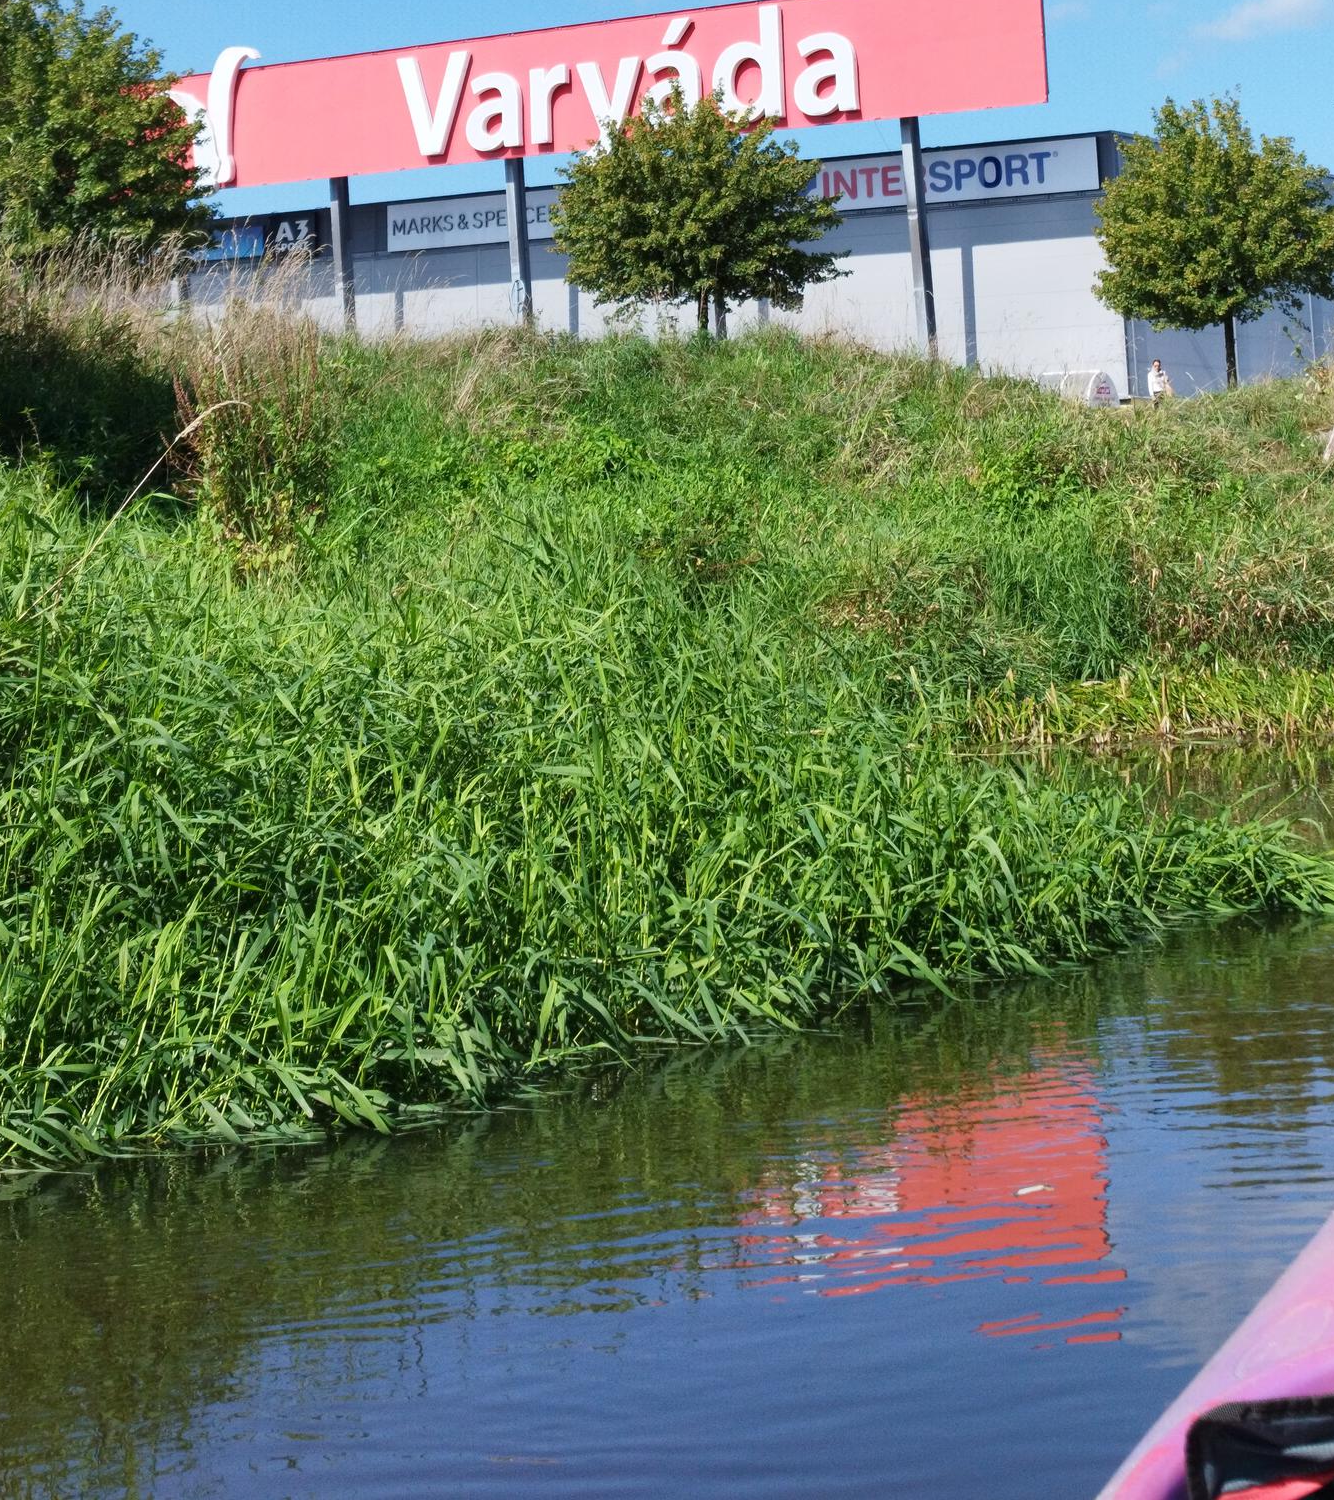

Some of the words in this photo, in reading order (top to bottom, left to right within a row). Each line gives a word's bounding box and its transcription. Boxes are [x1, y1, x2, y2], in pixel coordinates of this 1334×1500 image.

[396, 3, 860, 157] Varyáda
[822, 151, 1051, 200] INTESPORT
[275, 219, 310, 243] A3
[392, 213, 454, 237] MARKS
[457, 213, 470, 230] &
[472, 205, 559, 230] SPECE
